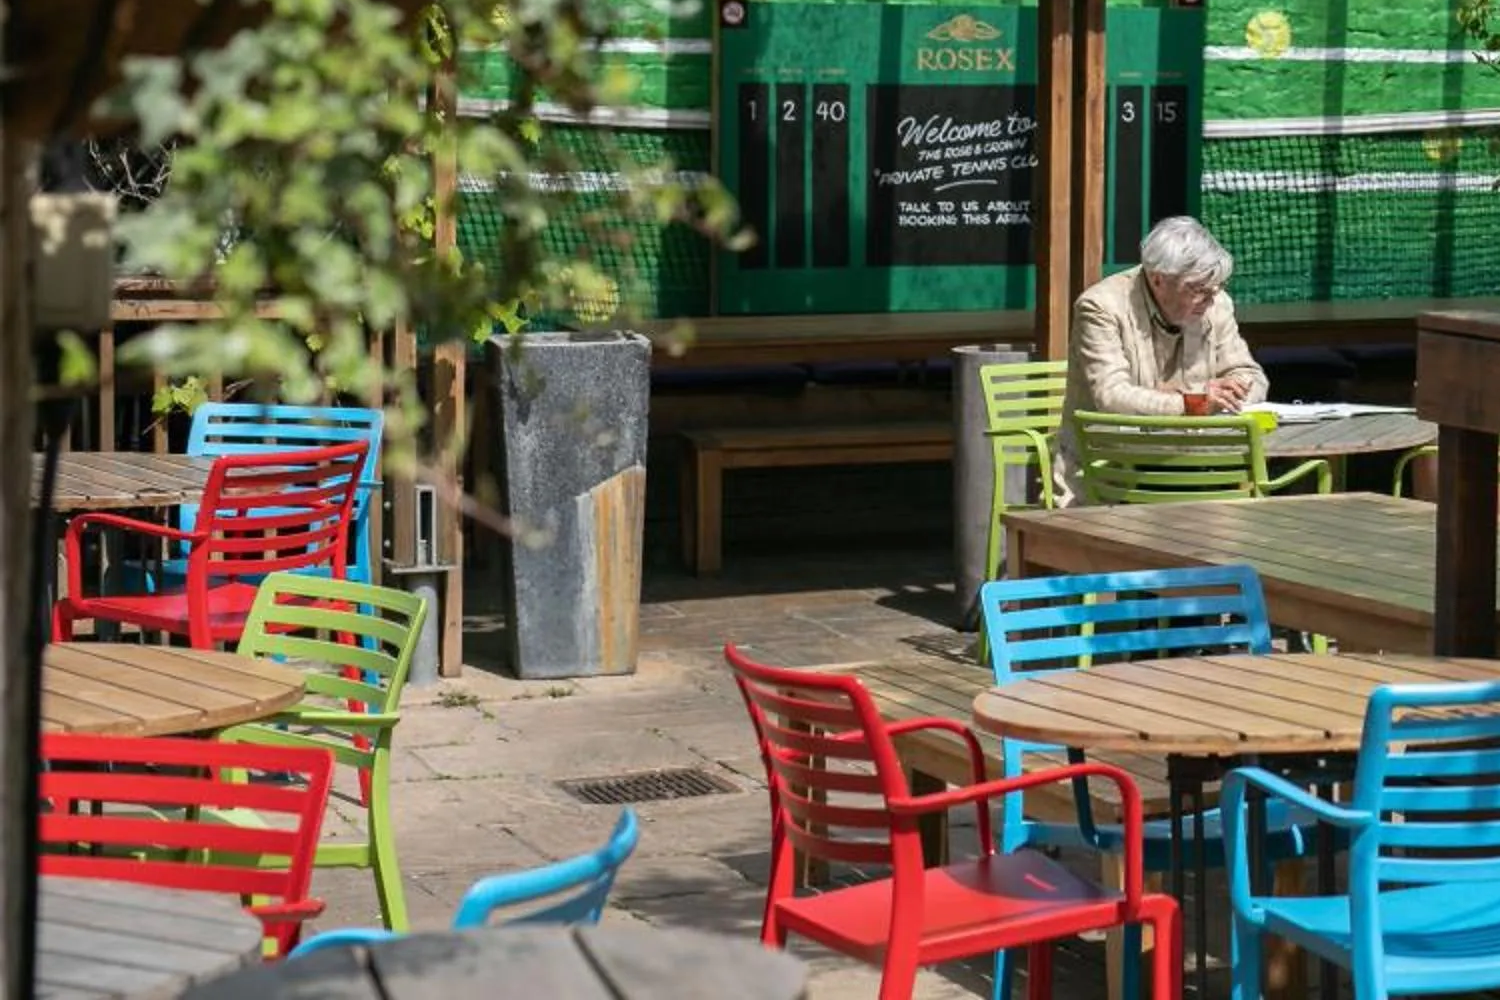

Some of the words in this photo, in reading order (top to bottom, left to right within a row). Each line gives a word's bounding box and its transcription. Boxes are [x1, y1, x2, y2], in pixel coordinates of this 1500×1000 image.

[917, 47, 1015, 71] ROSEX
[748, 100, 757, 121] 1
[782, 100, 796, 121] 2
[816, 100, 845, 122] 40
[1121, 101, 1135, 123] 3
[1156, 101, 1178, 123] 15
[897, 114, 1001, 147] Welcome
[917, 149, 941, 162] THE
[944, 146, 972, 159] ROSE
[983, 137, 1028, 153] CROWN
[951, 157, 1008, 177] TENNIS
[1011, 154, 1039, 169] CLU
[899, 202, 931, 213] TALK
[936, 202, 955, 213] TO
[961, 201, 980, 212] US
[987, 200, 1031, 212] ABOUT
[899, 215, 958, 226] BOOKING
[962, 214, 991, 225] THIS
[995, 213, 1031, 225] AREA
